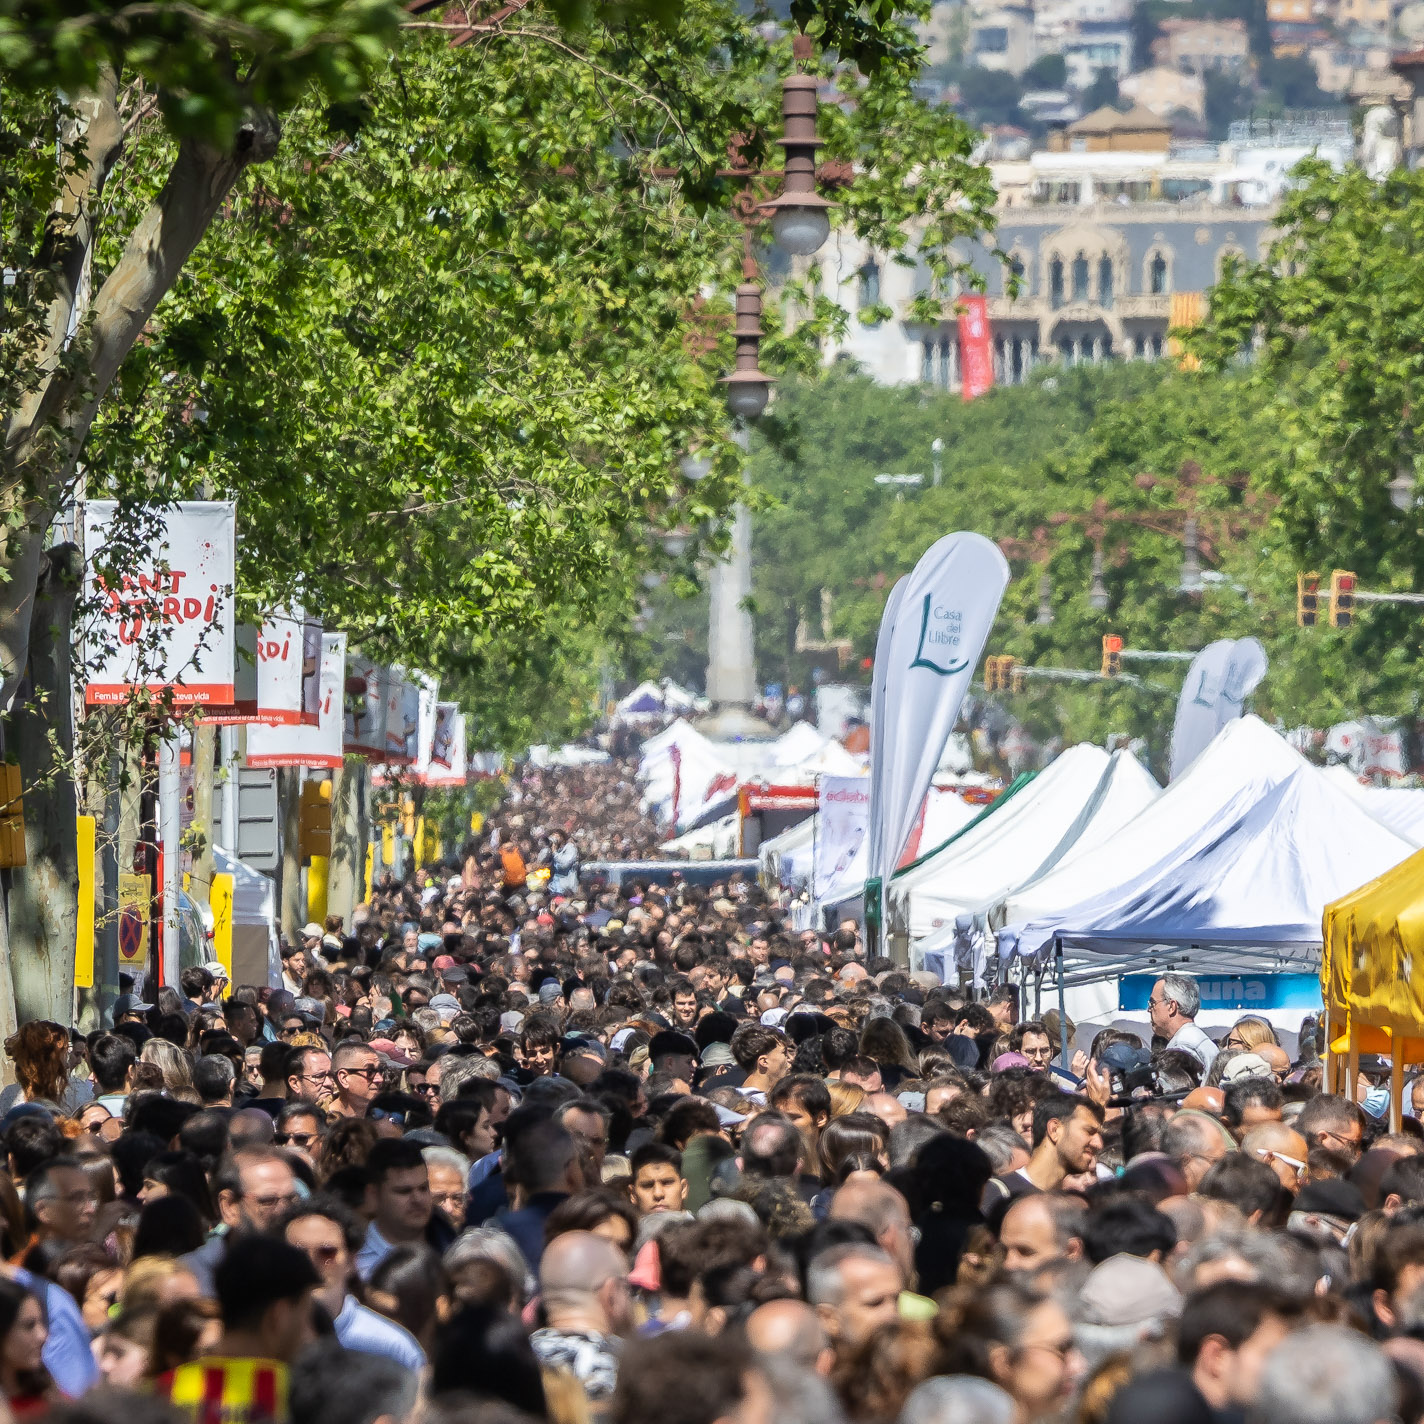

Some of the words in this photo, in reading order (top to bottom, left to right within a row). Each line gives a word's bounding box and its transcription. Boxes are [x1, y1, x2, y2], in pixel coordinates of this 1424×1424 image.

[933, 606, 962, 621] Casa
[946, 623, 961, 634] del
[928, 630, 961, 646] Llibre
